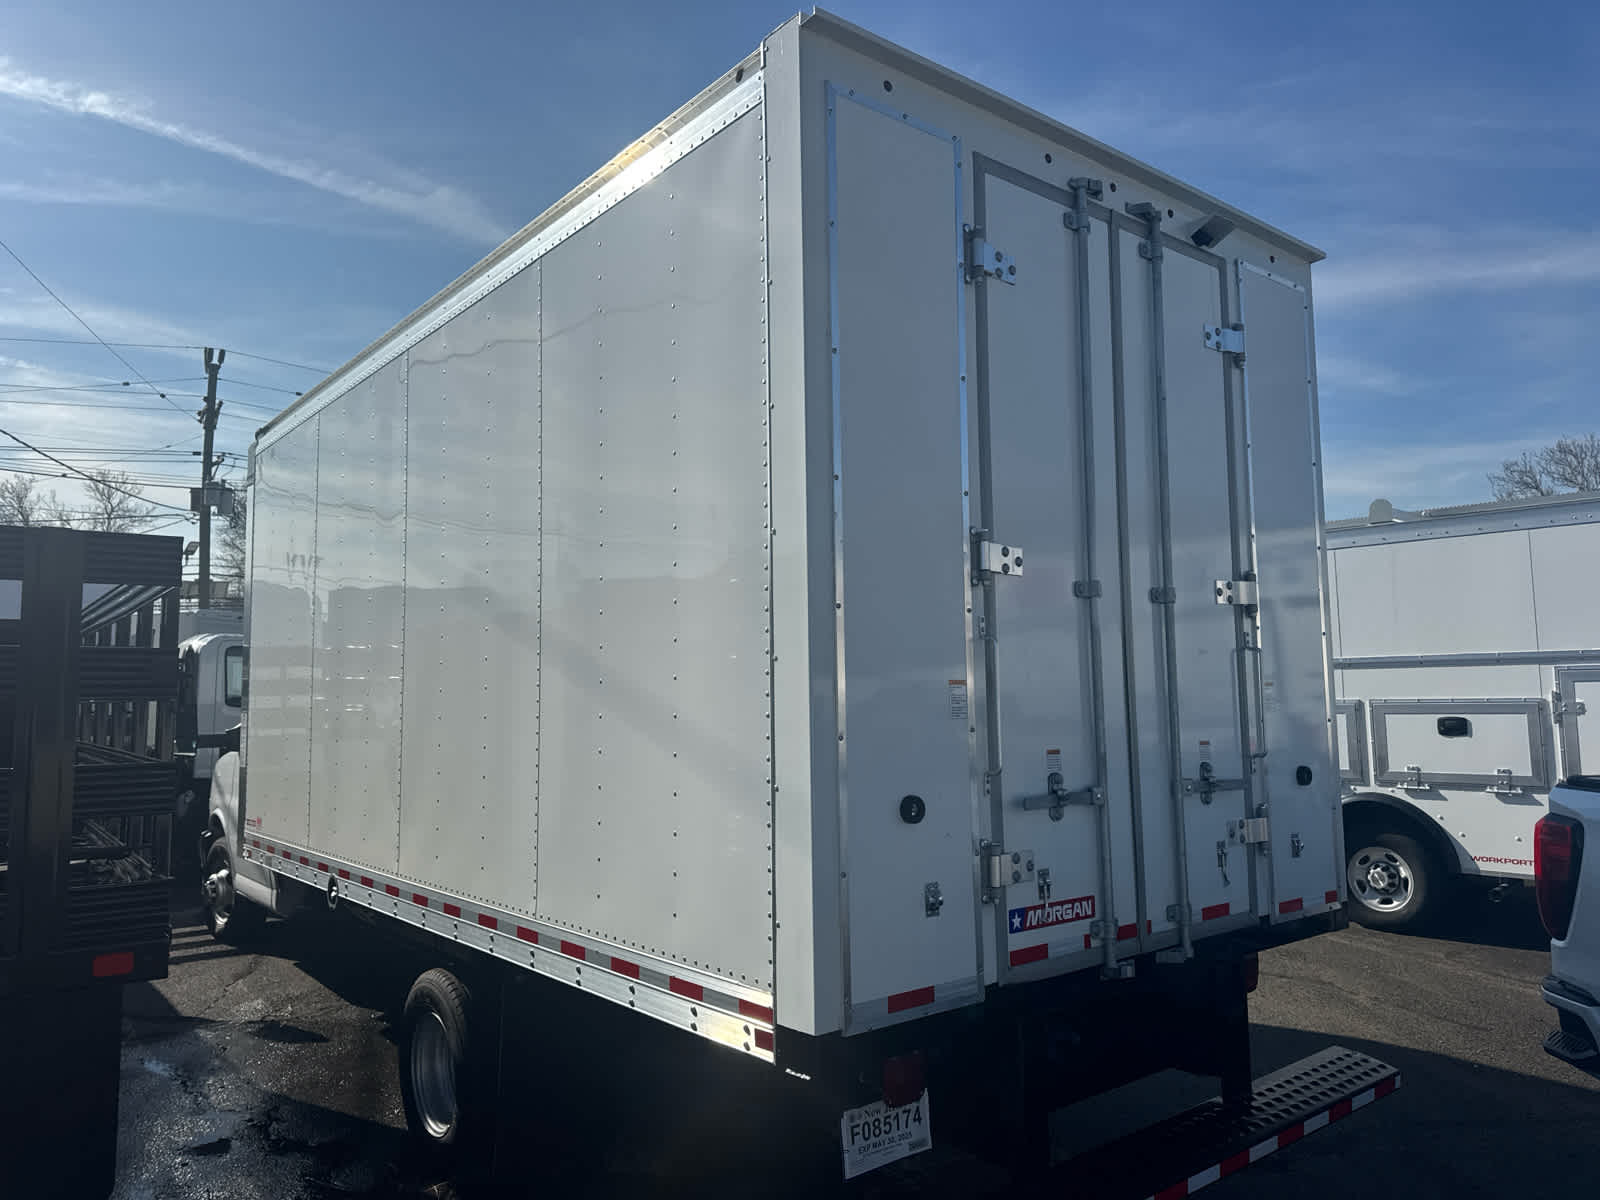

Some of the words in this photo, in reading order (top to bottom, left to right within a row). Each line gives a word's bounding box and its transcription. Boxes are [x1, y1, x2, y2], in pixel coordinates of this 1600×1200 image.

[1472, 856, 1535, 866] WORKPORT
[1026, 900, 1092, 927] MORGAN
[850, 1106, 922, 1145] F085174
